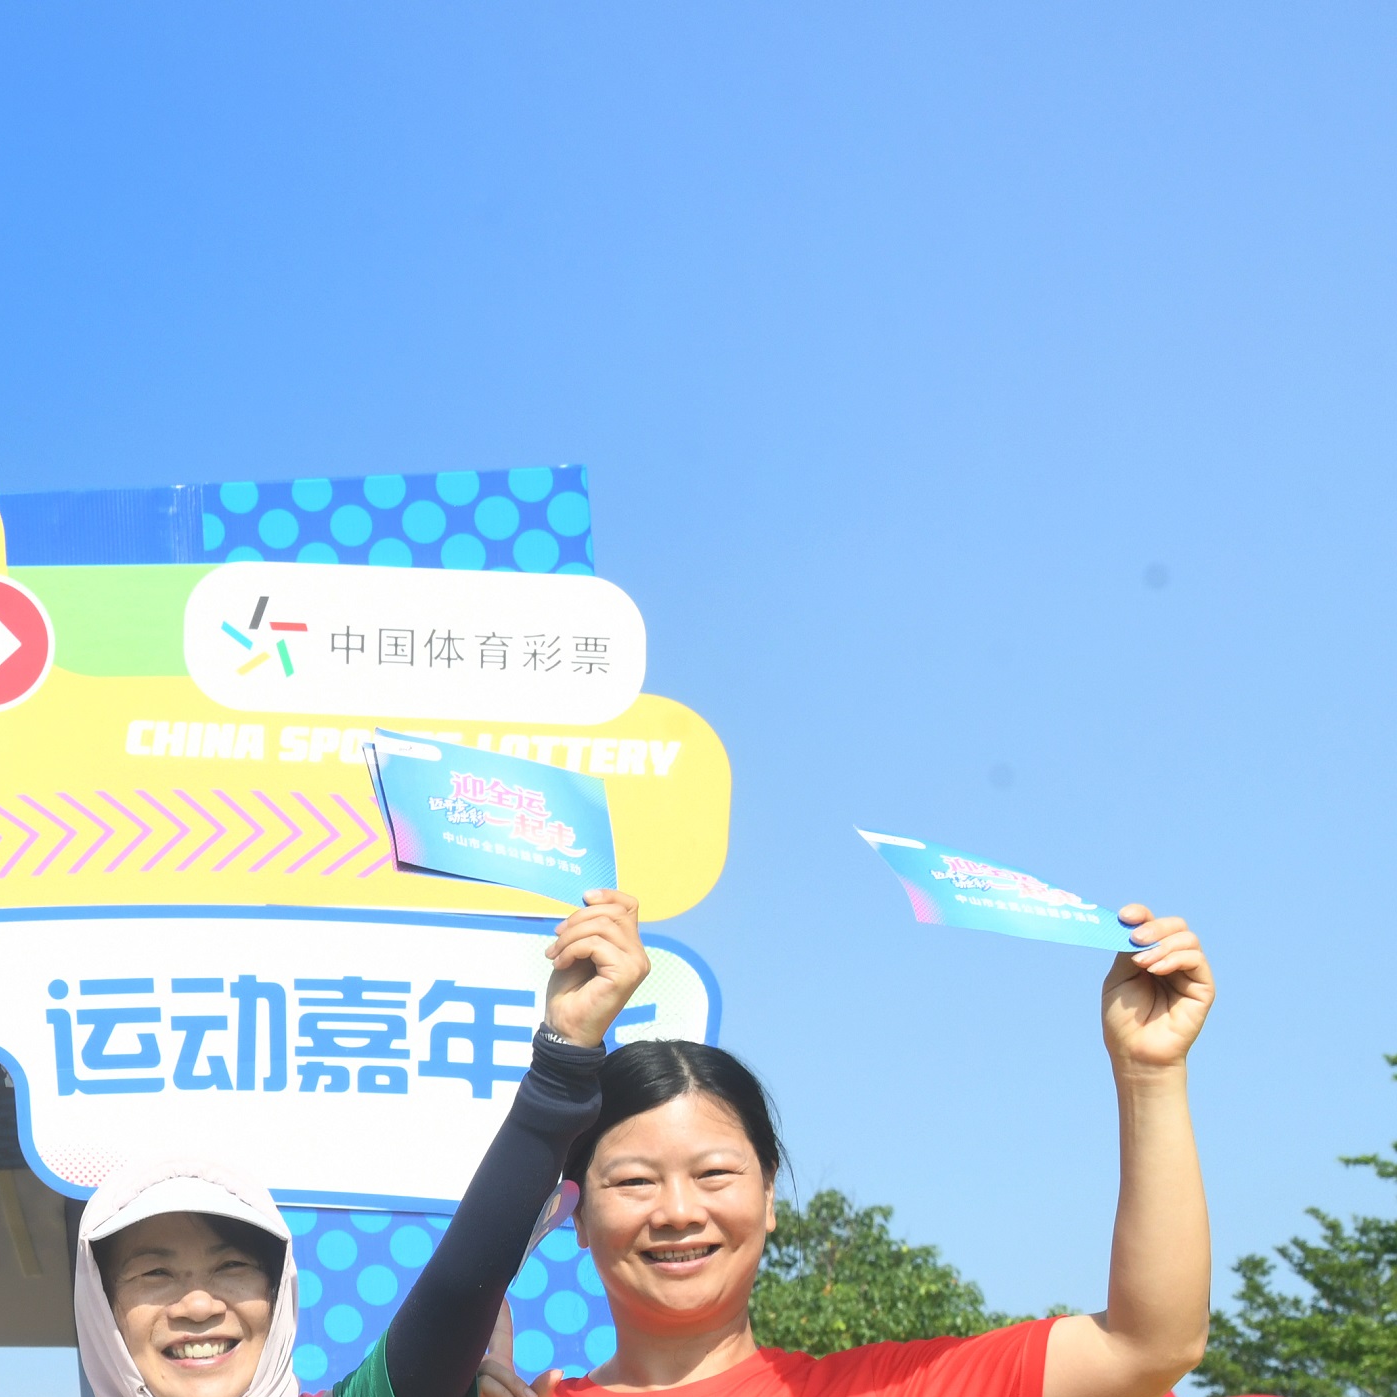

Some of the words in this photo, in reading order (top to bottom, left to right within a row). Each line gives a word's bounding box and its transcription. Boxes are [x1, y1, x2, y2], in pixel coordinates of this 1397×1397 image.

[329, 625, 612, 676] 中国体育彩票
[125, 719, 265, 761] CHINA
[450, 771, 551, 818] 迎全运
[484, 812, 587, 859] 一起走
[46, 973, 657, 1099] 运动嘉年
